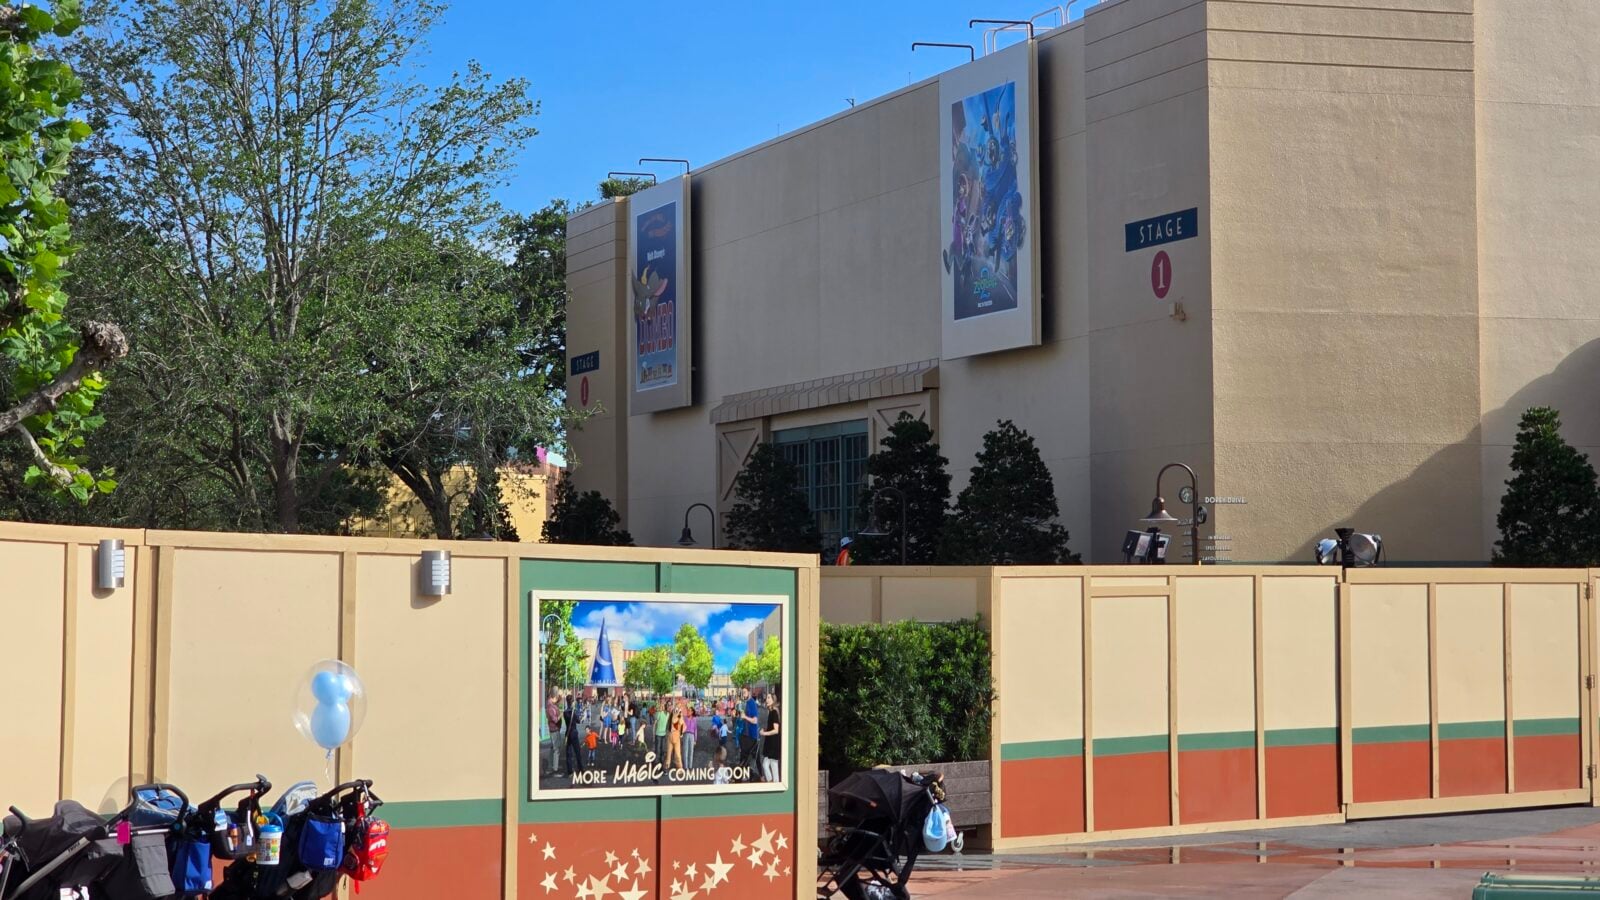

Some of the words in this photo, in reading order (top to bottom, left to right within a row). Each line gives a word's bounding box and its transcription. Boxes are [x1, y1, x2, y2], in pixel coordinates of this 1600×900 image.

[1139, 217, 1182, 244] STAGE
[1157, 258, 1166, 289] 1
[576, 354, 593, 371] STAGE
[572, 770, 607, 785] MORE
[613, 751, 664, 785] MAGIC
[669, 767, 714, 782] COMING
[716, 765, 750, 781] SOON
